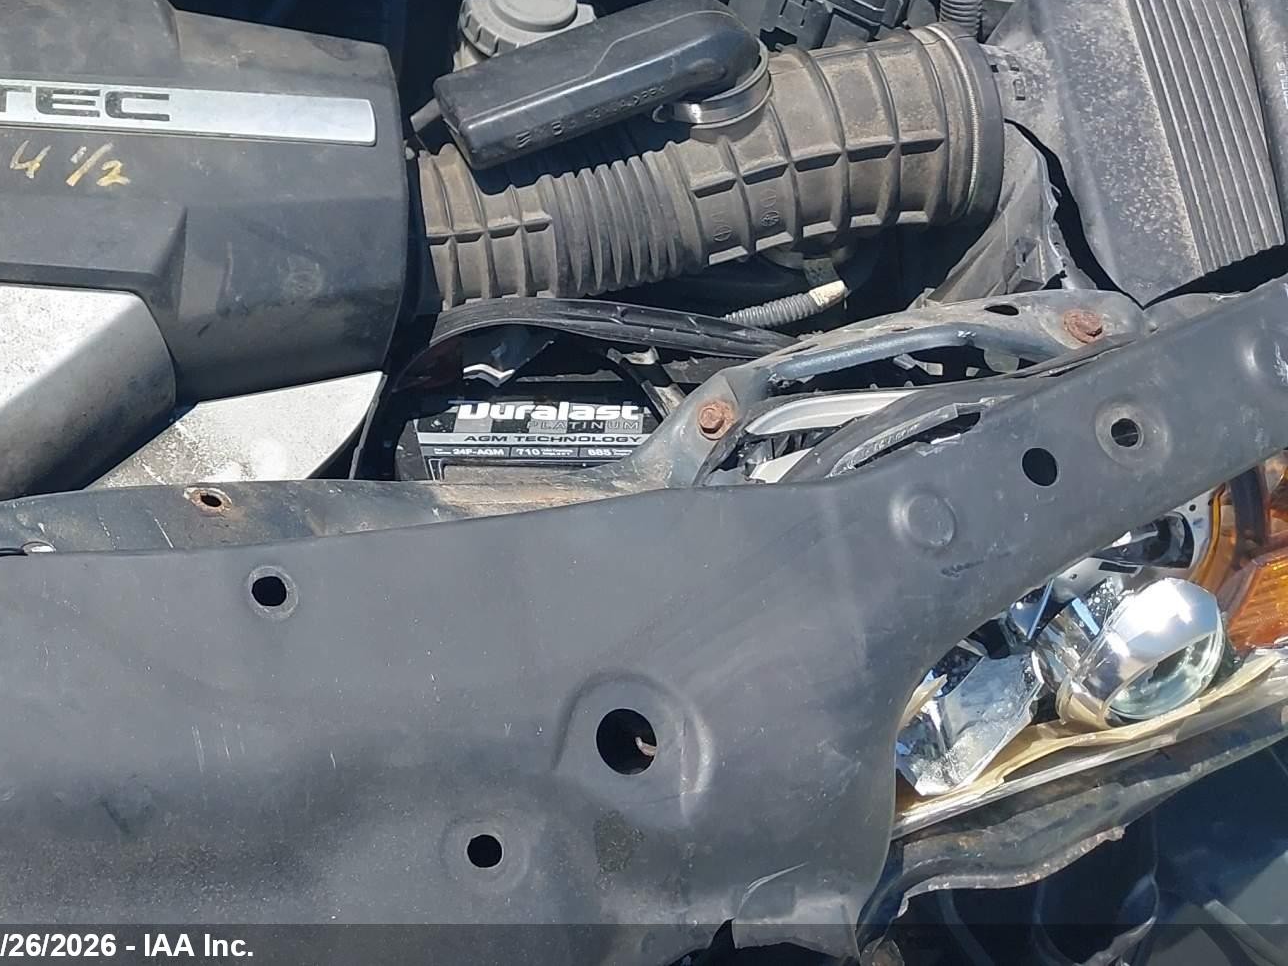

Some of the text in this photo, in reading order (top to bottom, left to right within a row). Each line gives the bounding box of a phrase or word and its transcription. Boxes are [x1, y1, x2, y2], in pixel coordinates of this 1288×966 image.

[458, 401, 639, 421] Duralast
[526, 420, 640, 431] PLATINUM
[464, 435, 642, 443] AGM TECHNOLOGY
[515, 448, 541, 456] 710
